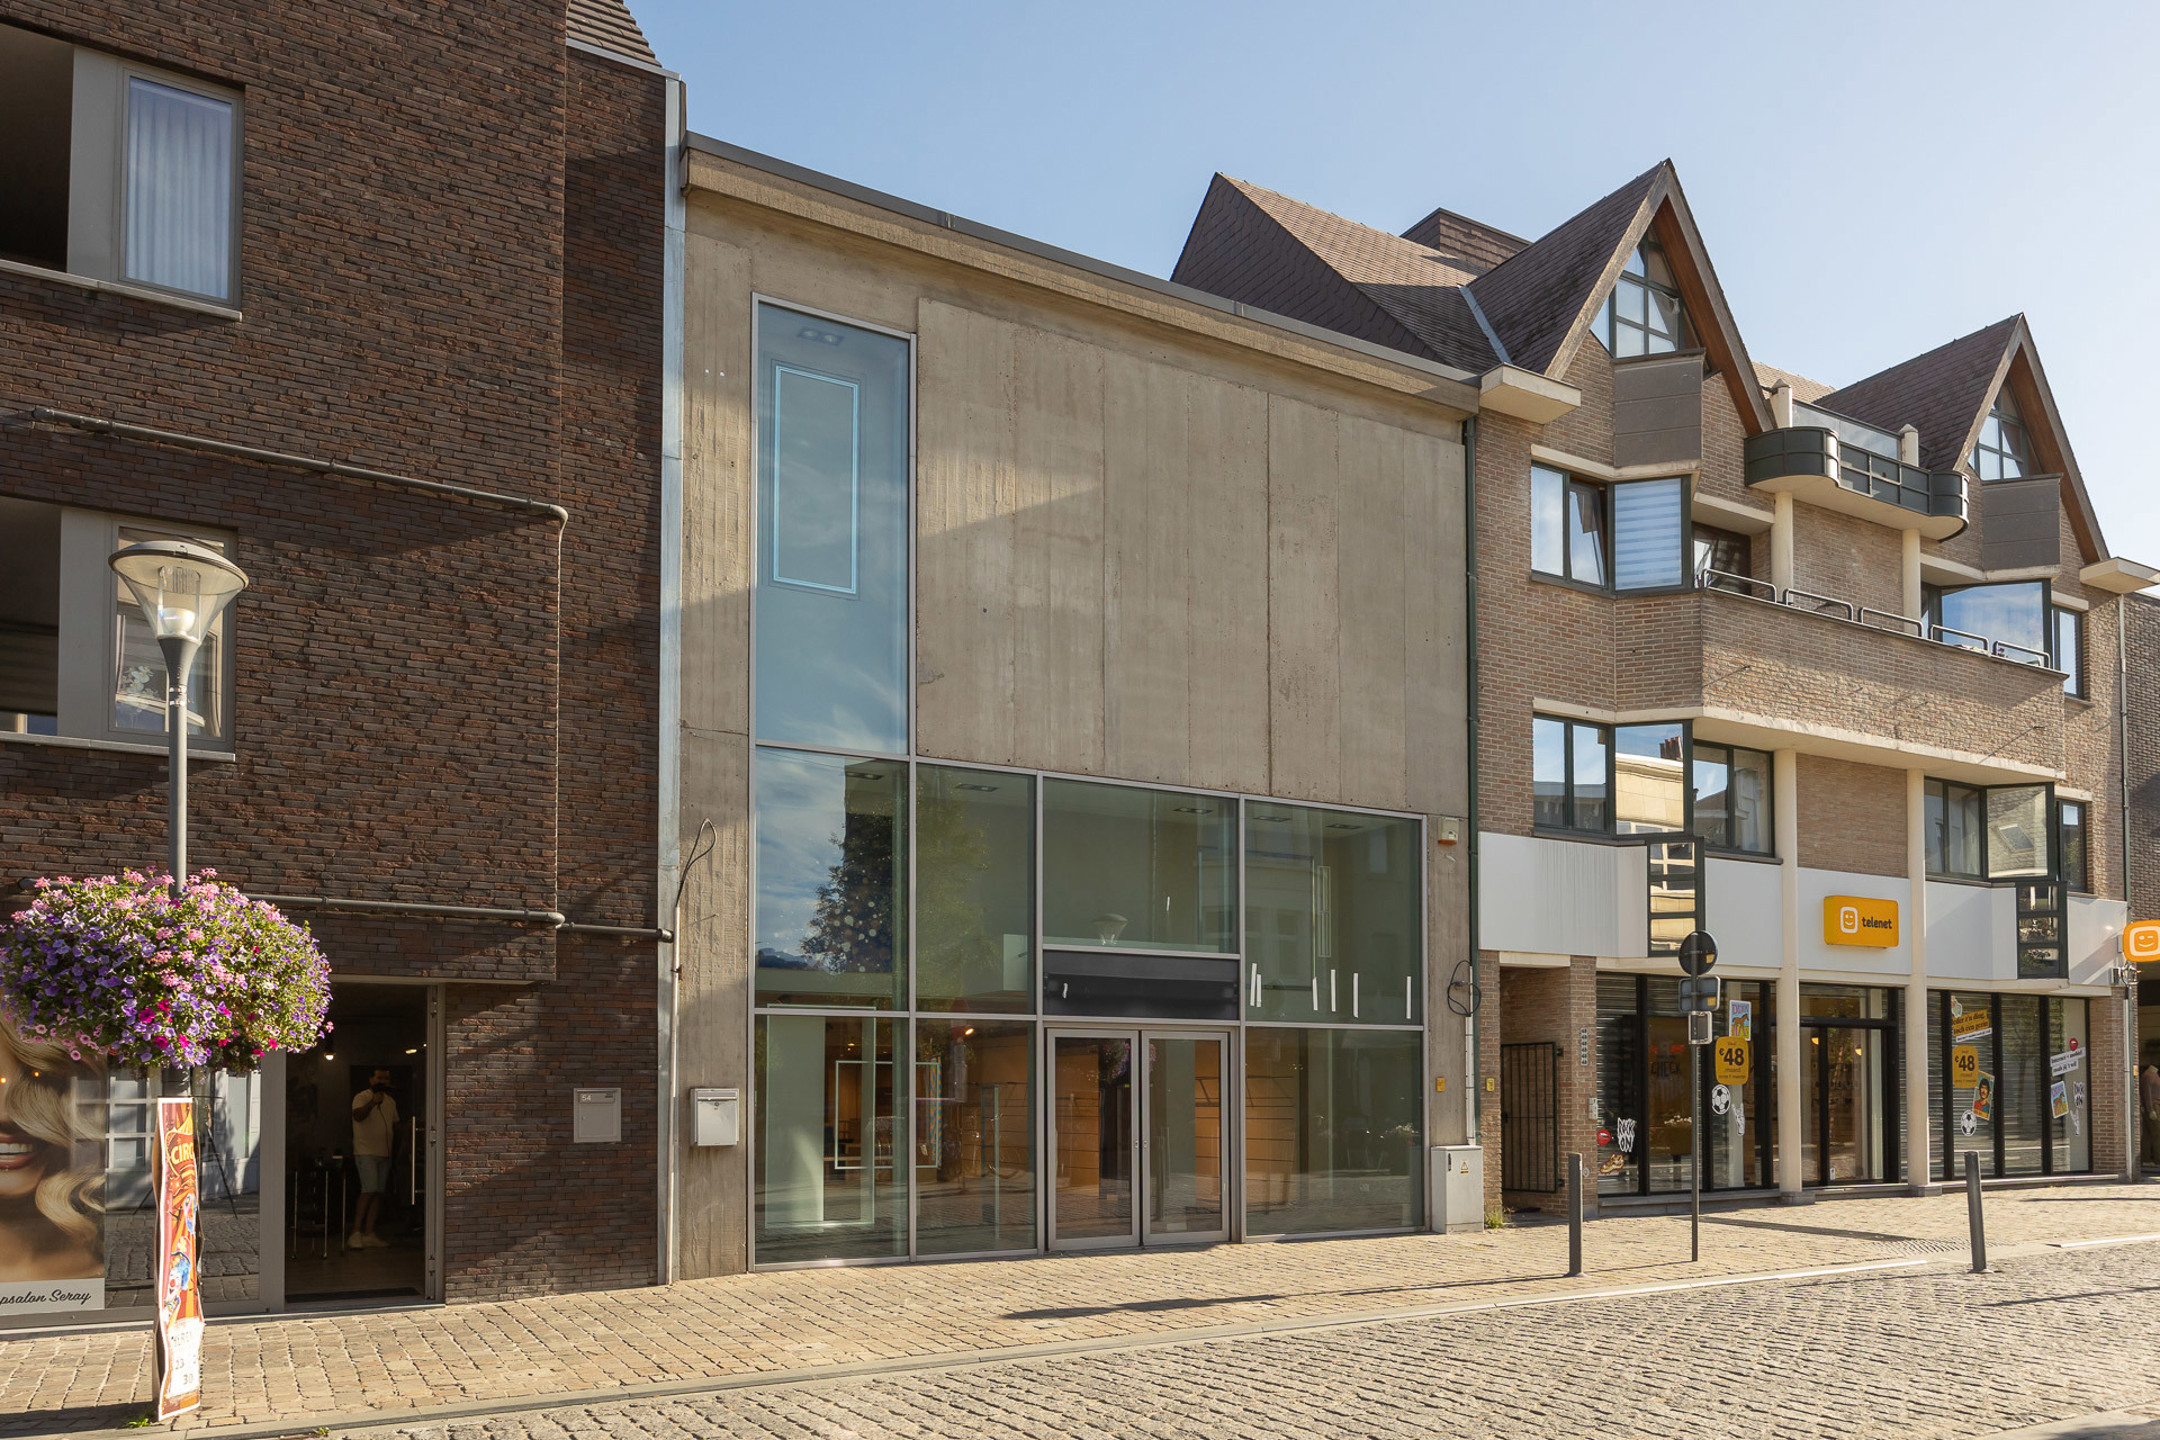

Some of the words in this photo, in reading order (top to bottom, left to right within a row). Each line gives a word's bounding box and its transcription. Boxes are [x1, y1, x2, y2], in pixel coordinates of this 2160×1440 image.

[1861, 916, 1893, 930] telenet
[1719, 1047, 1745, 1067] €48
[1954, 1055, 1975, 1072] €48
[1619, 1135, 1635, 1153] ON
[49, 1288, 92, 1306] Seray
